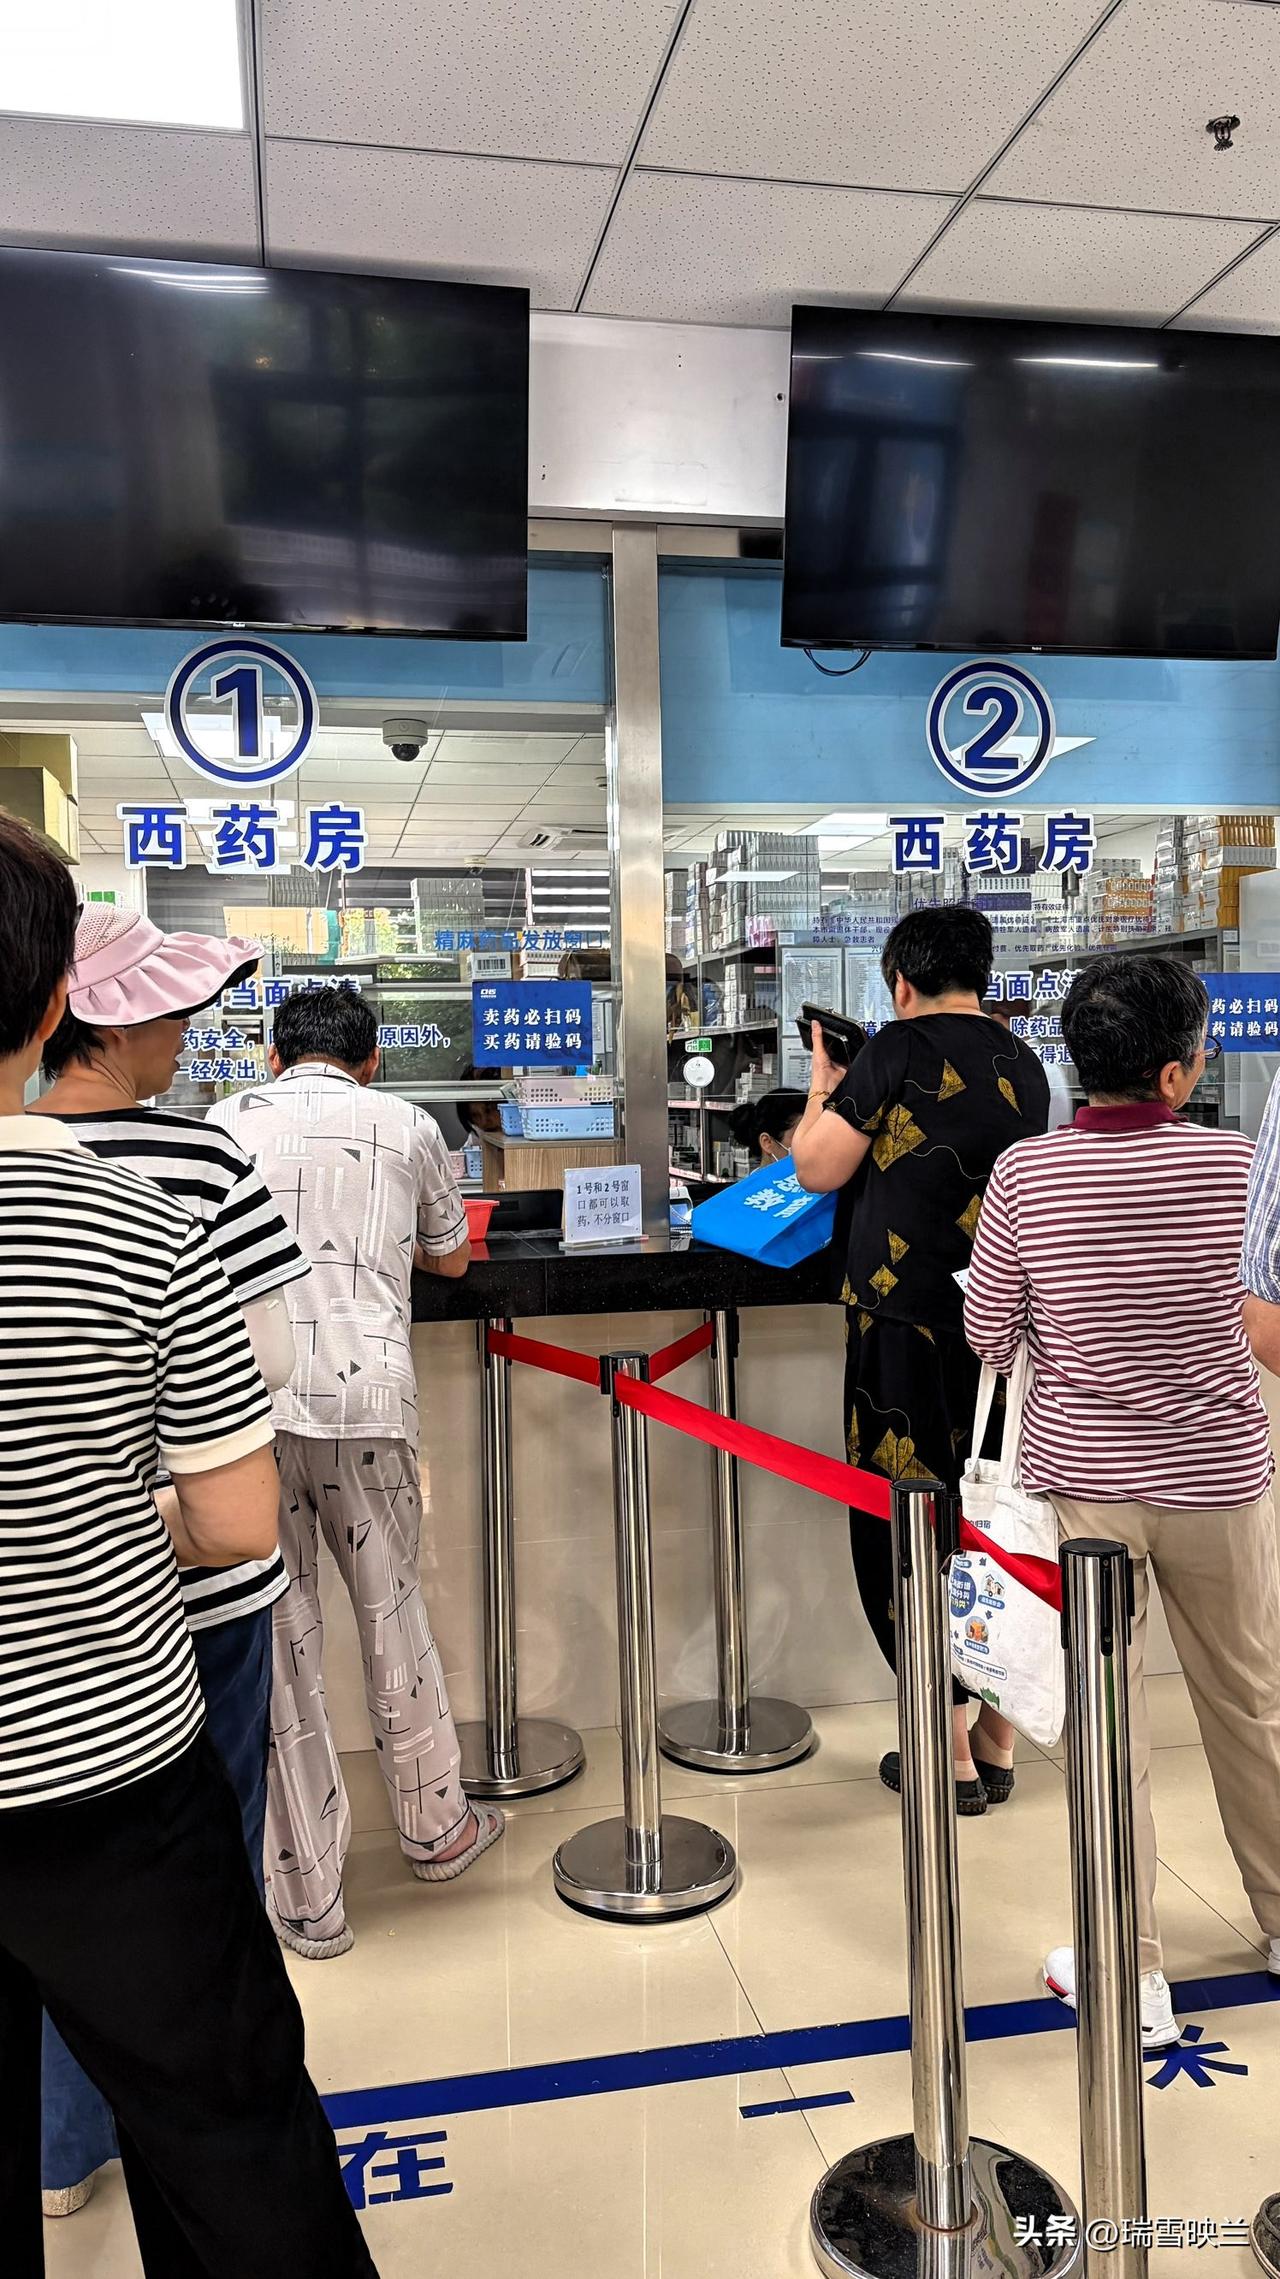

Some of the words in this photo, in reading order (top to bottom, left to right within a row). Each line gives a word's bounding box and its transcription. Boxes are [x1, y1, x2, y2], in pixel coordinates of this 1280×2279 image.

[123, 804, 367, 870] 西药房
[888, 812, 1095, 873] 西药房
[1211, 998, 1279, 1015] 药必扫码
[483, 1008, 582, 1026] 卖药必扫码
[1211, 1021, 1279, 1037] 药请验码
[483, 1033, 582, 1050] 买药请验码
[1031, 1045, 1074, 1065] 得退
[576, 1180, 630, 1195] 1号和2号窗
[577, 1196, 630, 1210] 口都可以取
